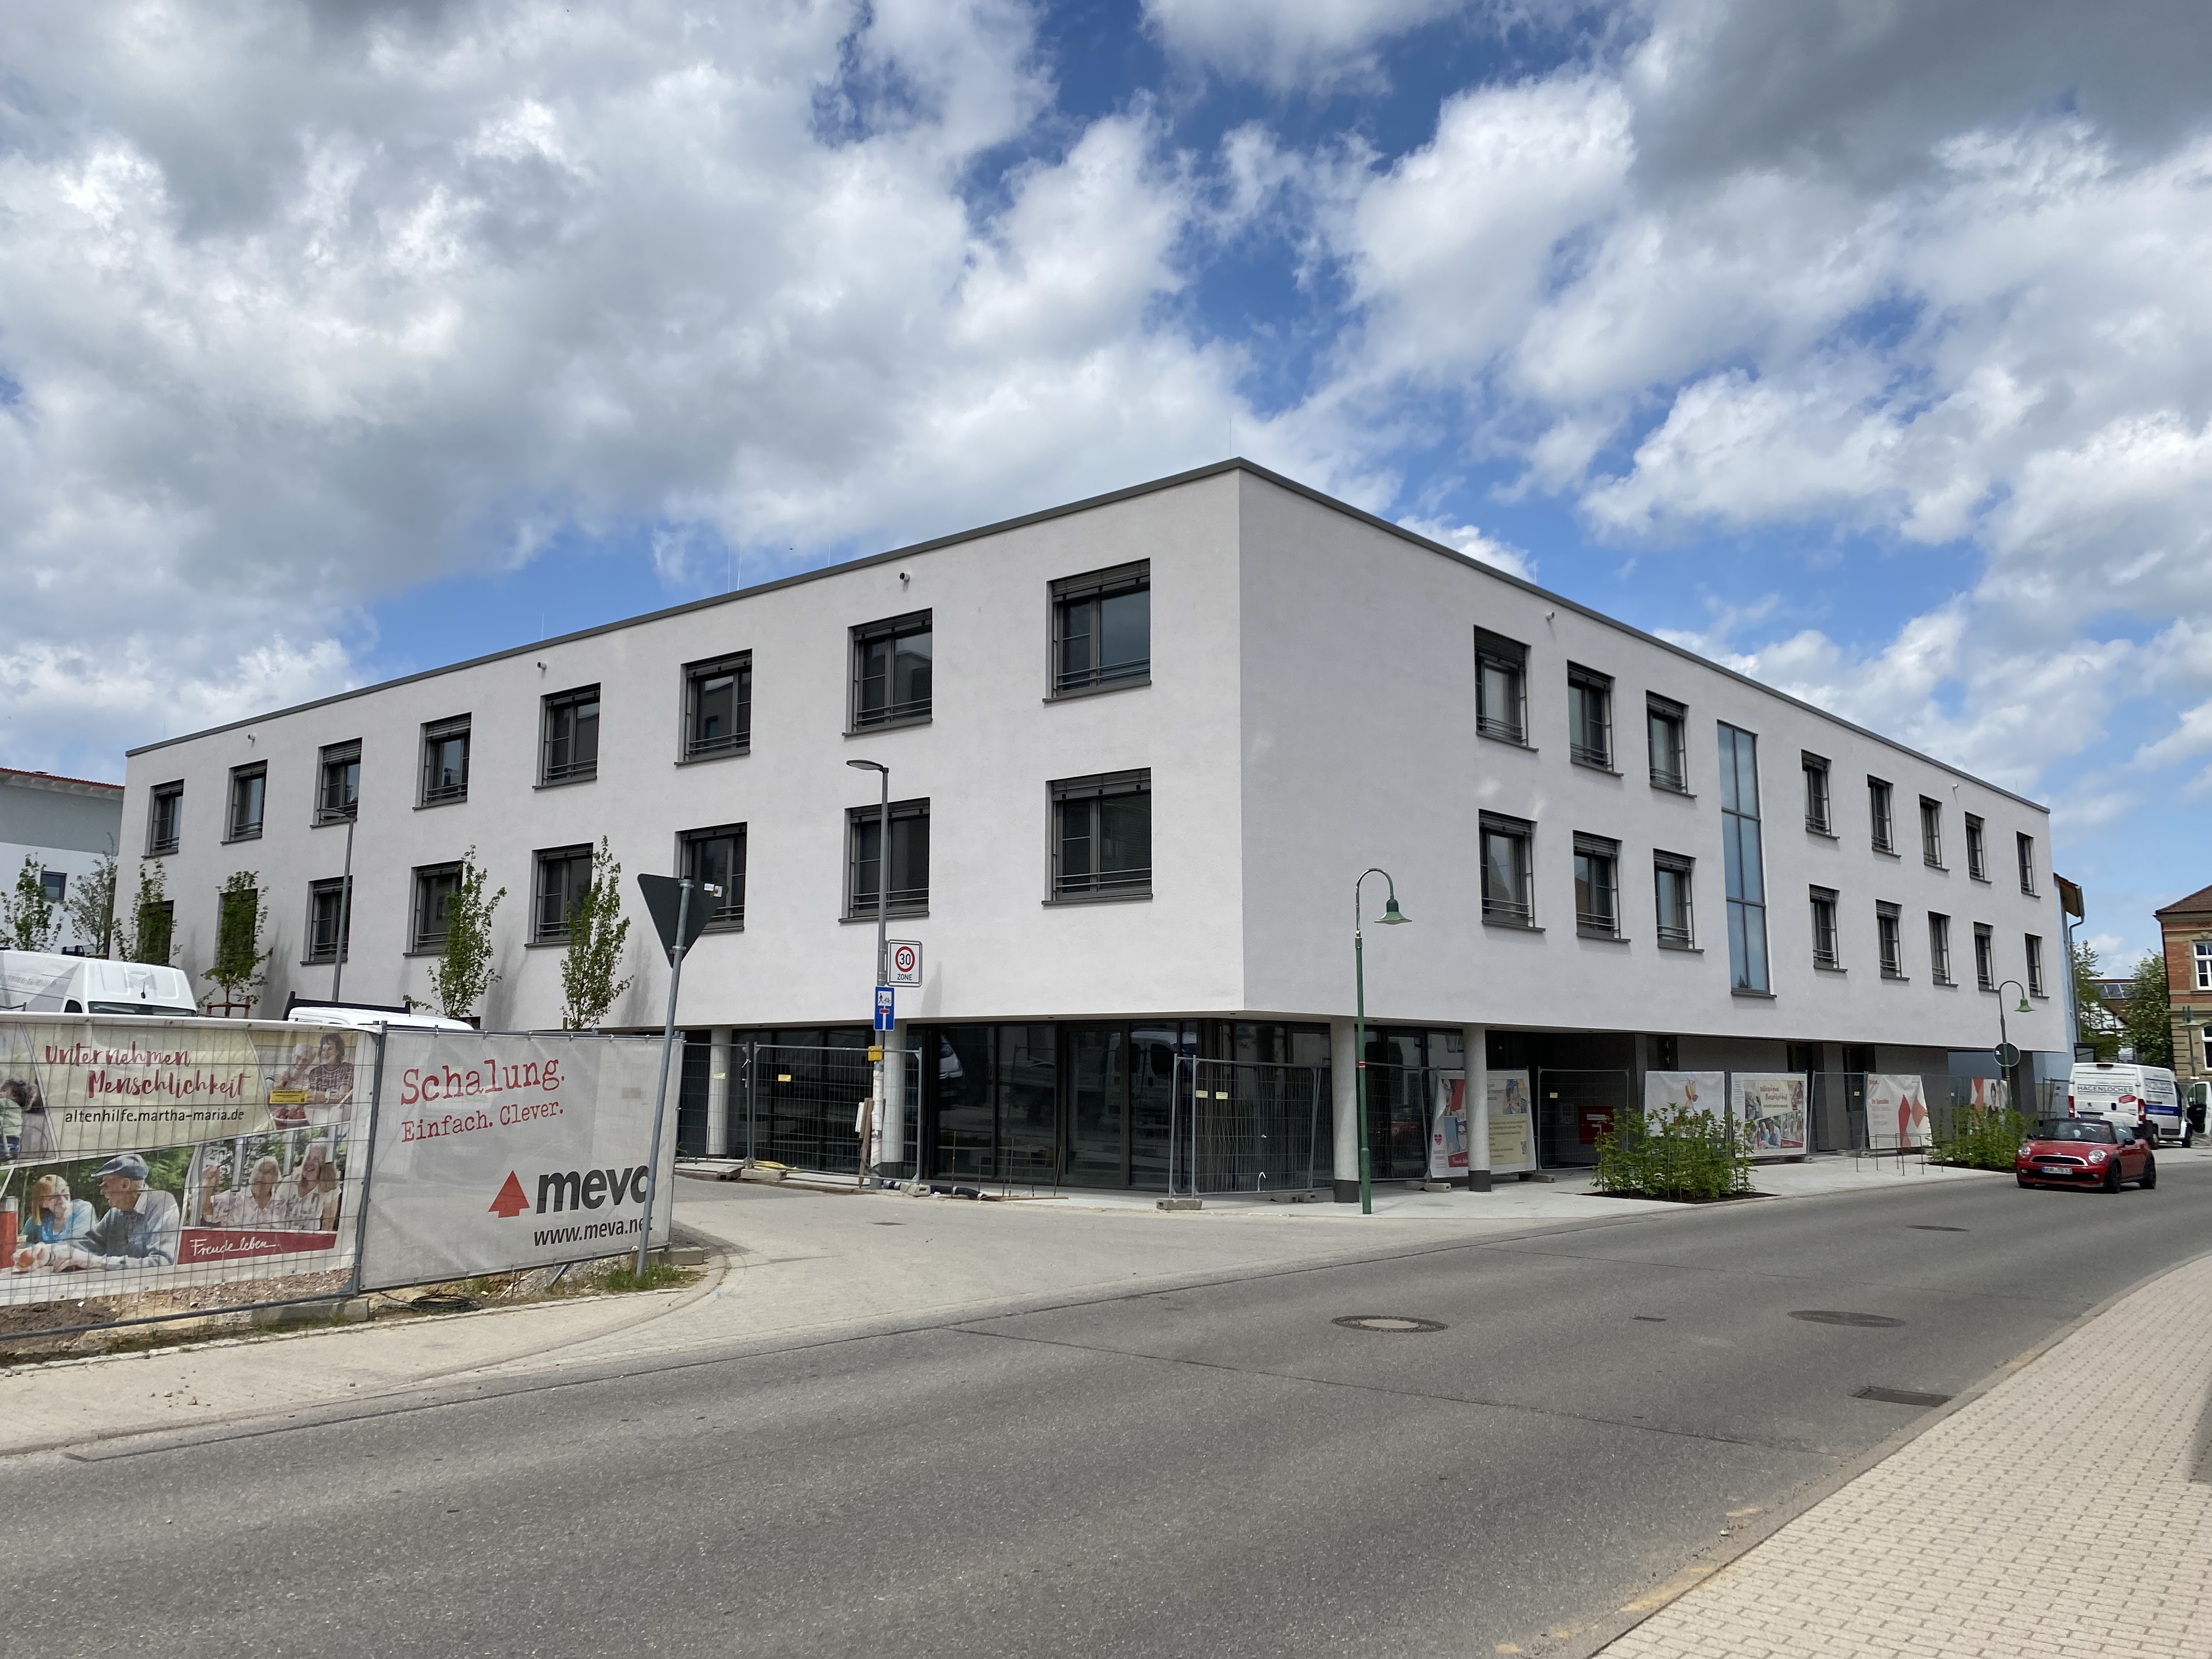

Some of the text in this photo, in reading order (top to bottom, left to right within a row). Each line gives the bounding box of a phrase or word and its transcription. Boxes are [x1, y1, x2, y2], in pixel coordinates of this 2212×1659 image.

[899, 953, 911, 966] 30
[45, 1041, 191, 1067] Unternehmen
[88, 1069, 251, 1099] Menschlichkeit
[400, 1059, 565, 1105] Schalung.
[65, 1108, 244, 1123] altenhilfe.martha-maria.de
[401, 1101, 563, 1143] Einfach. Clever.
[189, 1238, 239, 1256] Freude
